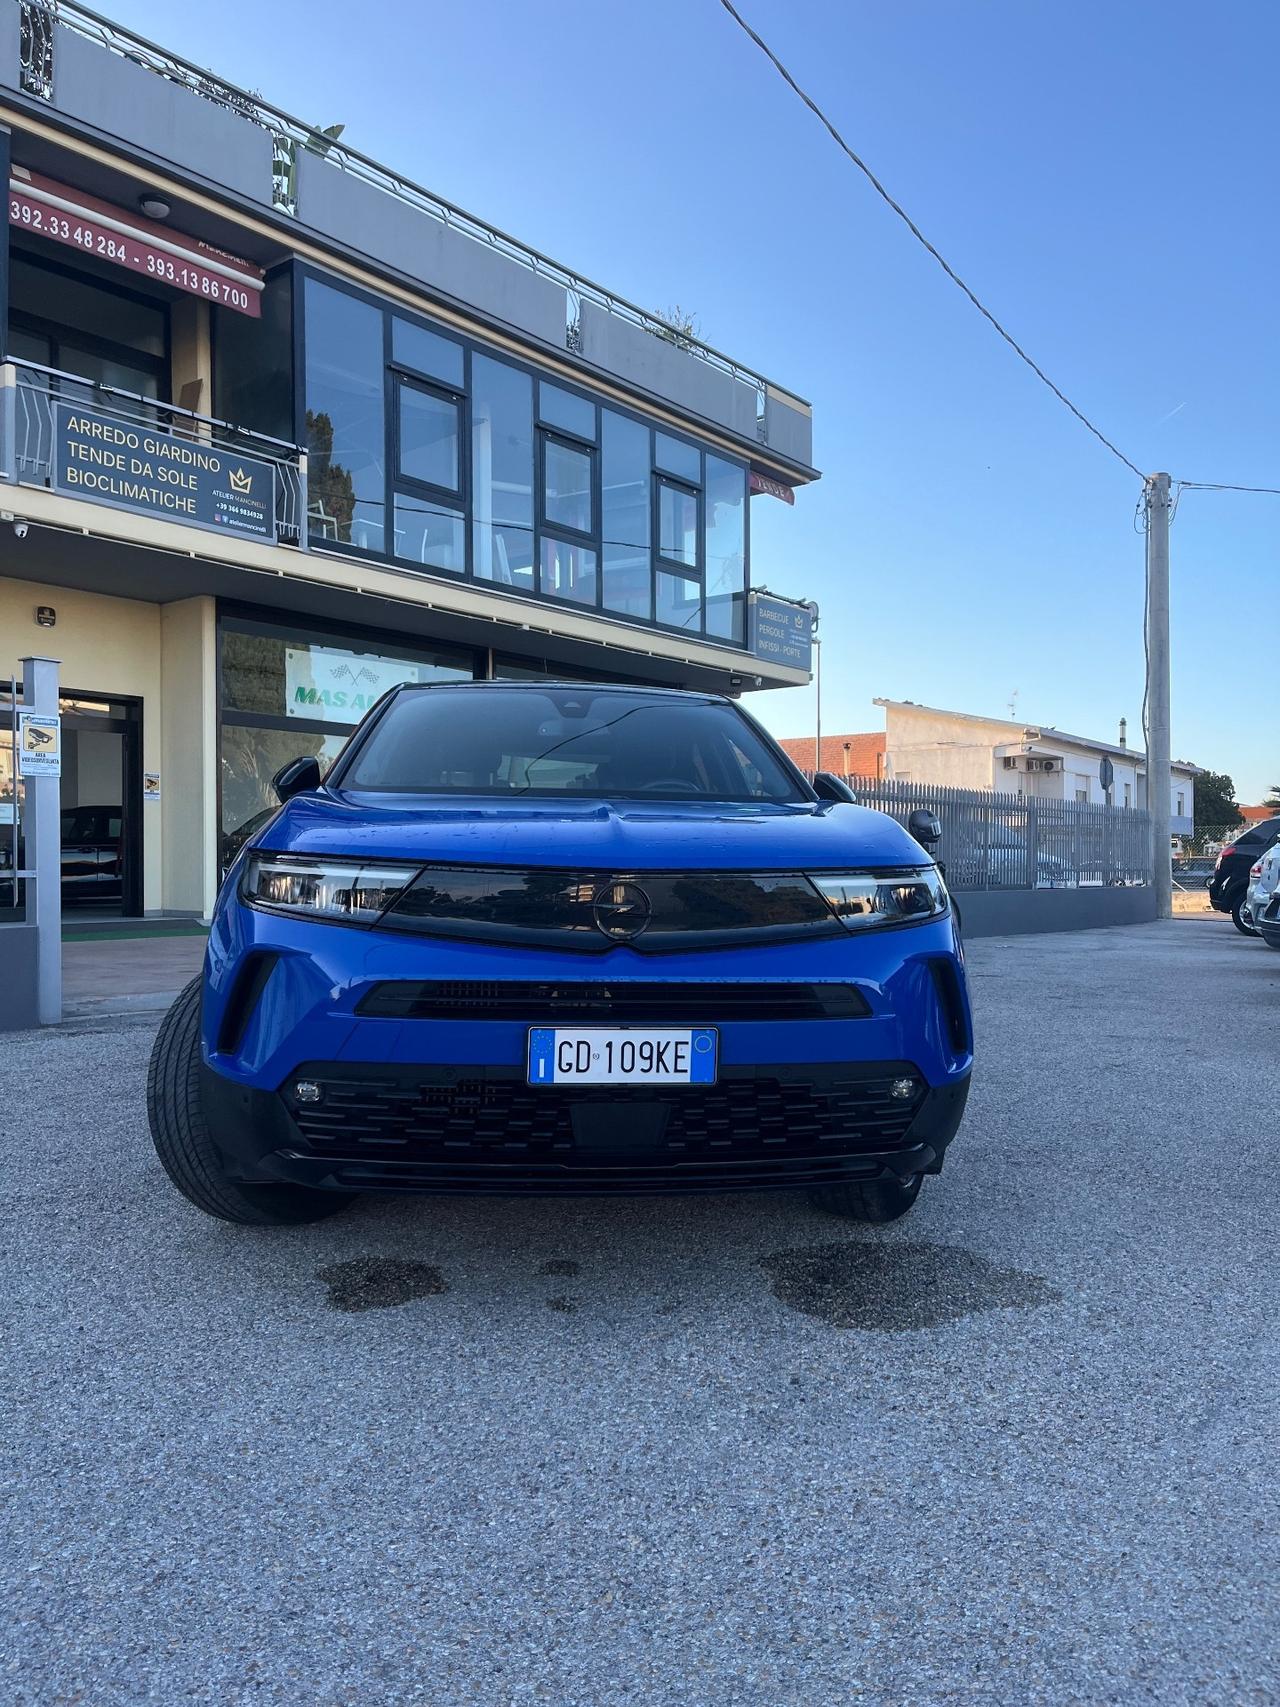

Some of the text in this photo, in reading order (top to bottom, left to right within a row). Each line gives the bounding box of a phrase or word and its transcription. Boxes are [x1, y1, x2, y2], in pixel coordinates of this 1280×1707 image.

[67, 416, 221, 473] ARREDO GIARDINO
[67, 441, 199, 491] TENDE DA SOLE
[66, 466, 197, 514] BIOCLIMATICHE
[211, 489, 267, 509] ATELIER MANCINELLI
[216, 502, 228, 511] +39
[759, 608, 790, 625] BARBECUE
[758, 624, 785, 639] PERGOLE
[758, 640, 780, 653] INFISSI
[783, 645, 801, 658] PORTE
[294, 686, 349, 708] MAS
[557, 1040, 690, 1073] GD 109KE
